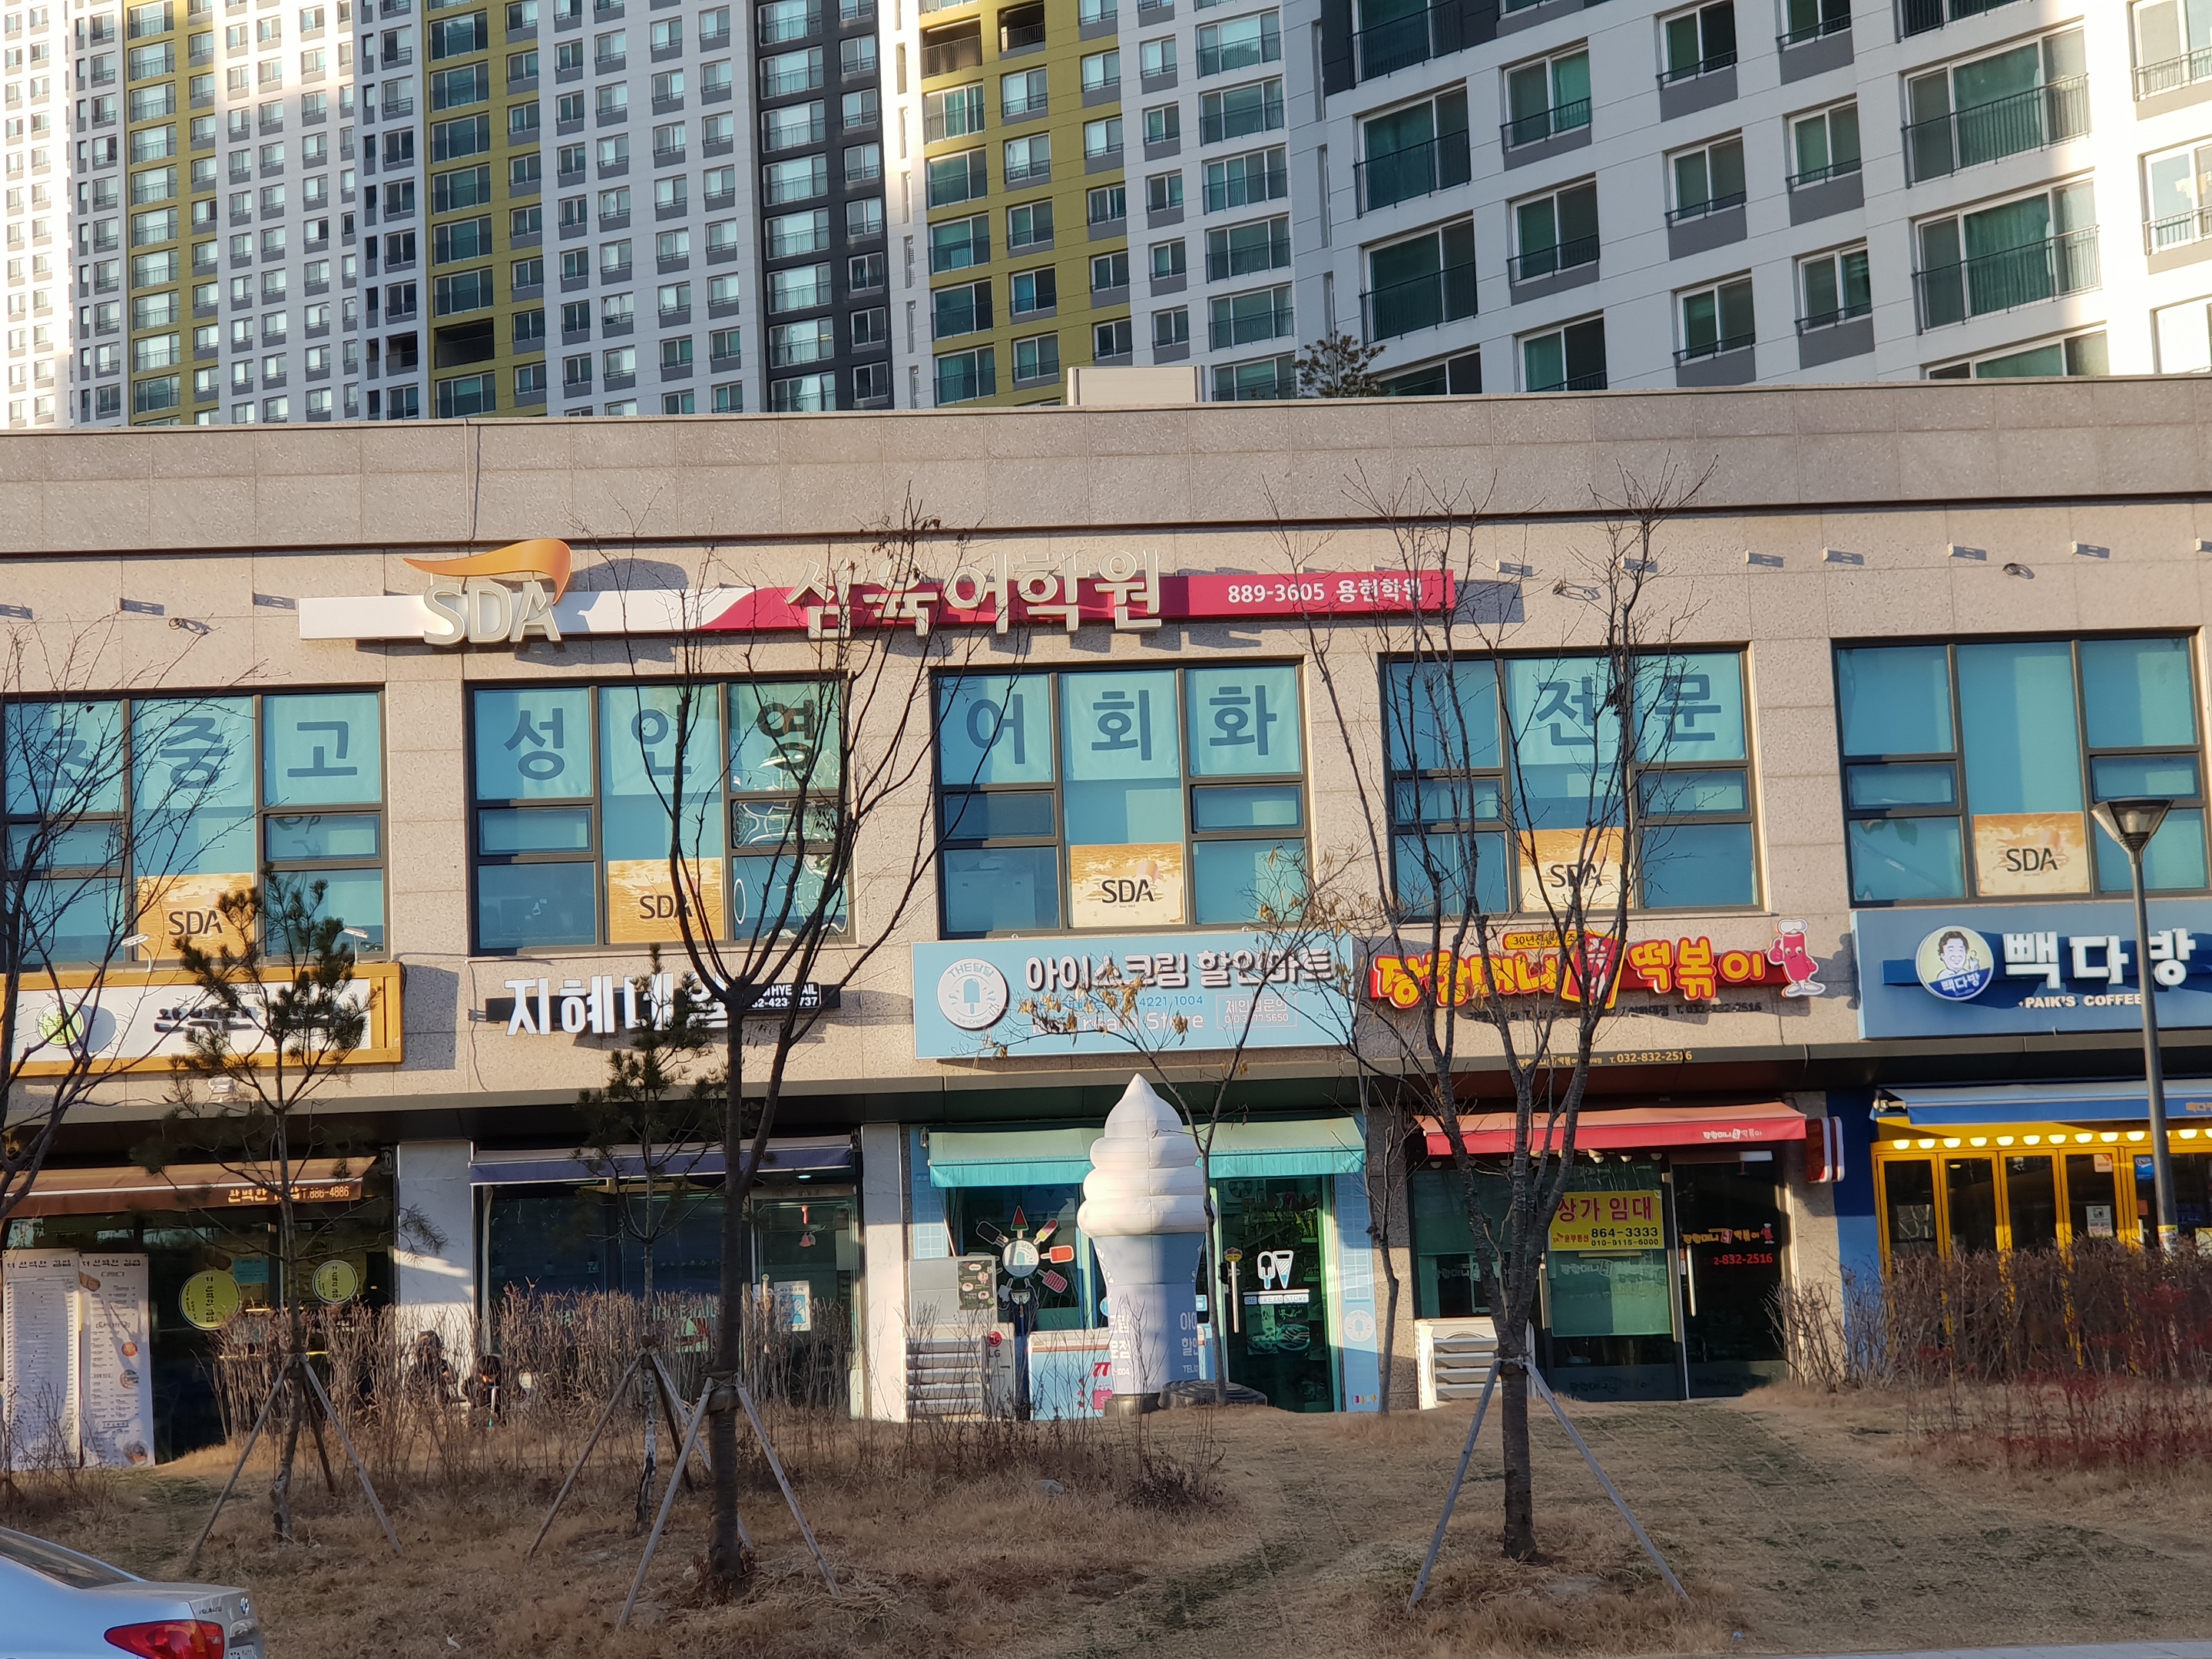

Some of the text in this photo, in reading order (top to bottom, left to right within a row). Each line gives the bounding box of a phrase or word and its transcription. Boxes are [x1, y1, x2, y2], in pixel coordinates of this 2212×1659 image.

[786, 547, 1162, 639] 삼육어학원
[1227, 578, 1423, 604] 889-3605 용현학원
[423, 581, 562, 644] SDA
[2006, 847, 2058, 873] SDA
[1101, 878, 1155, 904] SDA
[639, 894, 694, 919] SDA
[168, 911, 224, 936] SDA
[1025, 947, 1334, 991] 아이스크림 할인마트
[1628, 937, 1764, 1000] 떡볶이
[2002, 927, 2197, 990] 빽다방
[1941, 972, 1980, 992] 빽다방
[2023, 993, 2144, 1009] PAIK'S COFFEE
[1145, 1011, 1205, 1031] Store
[1224, 1012, 1290, 1024] 010.377.5650
[1557, 1195, 1654, 1223] 상가 임대
[1591, 1227, 1659, 1239] 864-3333
[1591, 1238, 1659, 1247] 010-9115-6000
[1284, 1293, 1308, 1303] STORE
